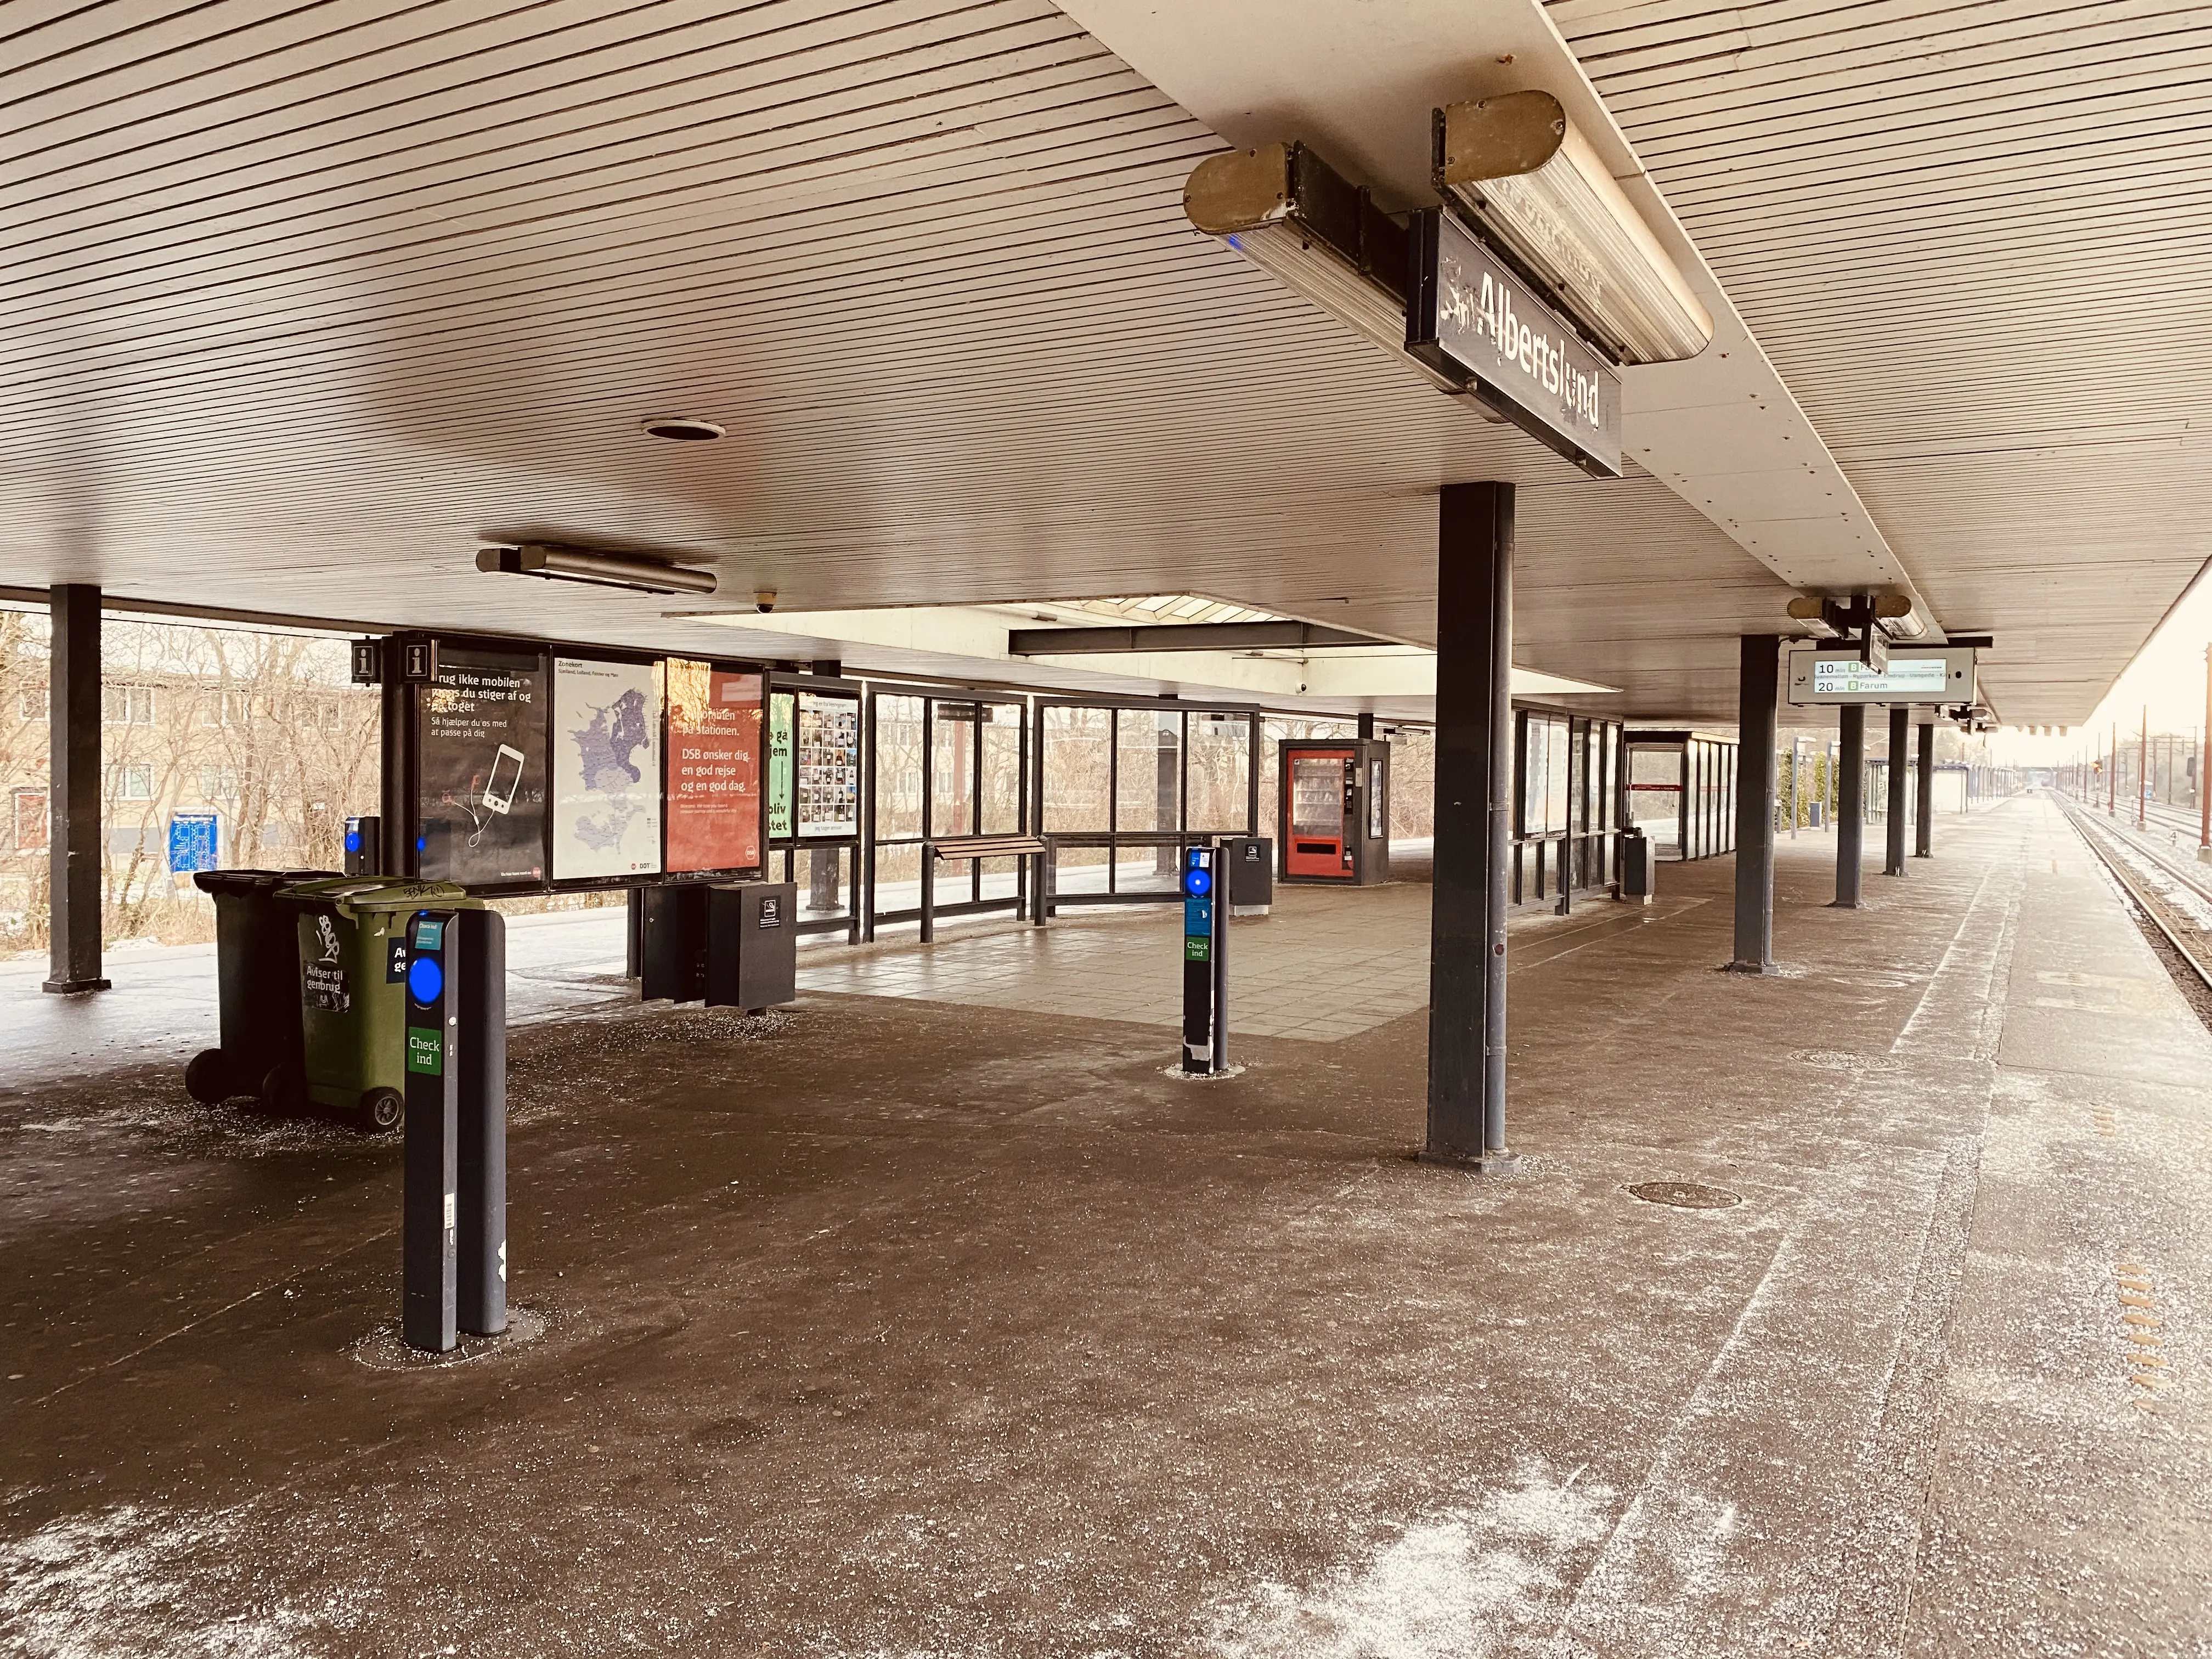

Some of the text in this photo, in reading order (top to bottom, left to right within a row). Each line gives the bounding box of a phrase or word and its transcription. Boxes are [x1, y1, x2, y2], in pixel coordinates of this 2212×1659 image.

[1477, 271, 1600, 427] Albertslund
[1819, 664, 1833, 674] 10
[438, 674, 520, 688] rug ikke mobilen
[1818, 682, 1833, 691] 20
[463, 687, 476, 698] du
[478, 689, 505, 702] stiger
[507, 690, 517, 701] af
[519, 693, 531, 703] og
[448, 701, 475, 713] toget
[431, 716, 440, 726] Så
[442, 717, 469, 727] hjælper
[471, 719, 480, 727] du
[441, 730, 461, 738] passe
[463, 729, 472, 738] på
[473, 729, 485, 738] dig
[776, 729, 788, 743] gå
[682, 748, 749, 763] DSB ønsker dig
[770, 744, 788, 760] jem
[681, 764, 736, 778] en god rejse
[681, 780, 746, 793] og en god dag.
[1187, 941, 1208, 950] Check
[307, 966, 343, 980] Aviser til
[307, 979, 341, 994] genbrug
[409, 1036, 439, 1052] Check
[416, 1052, 432, 1065] ind
